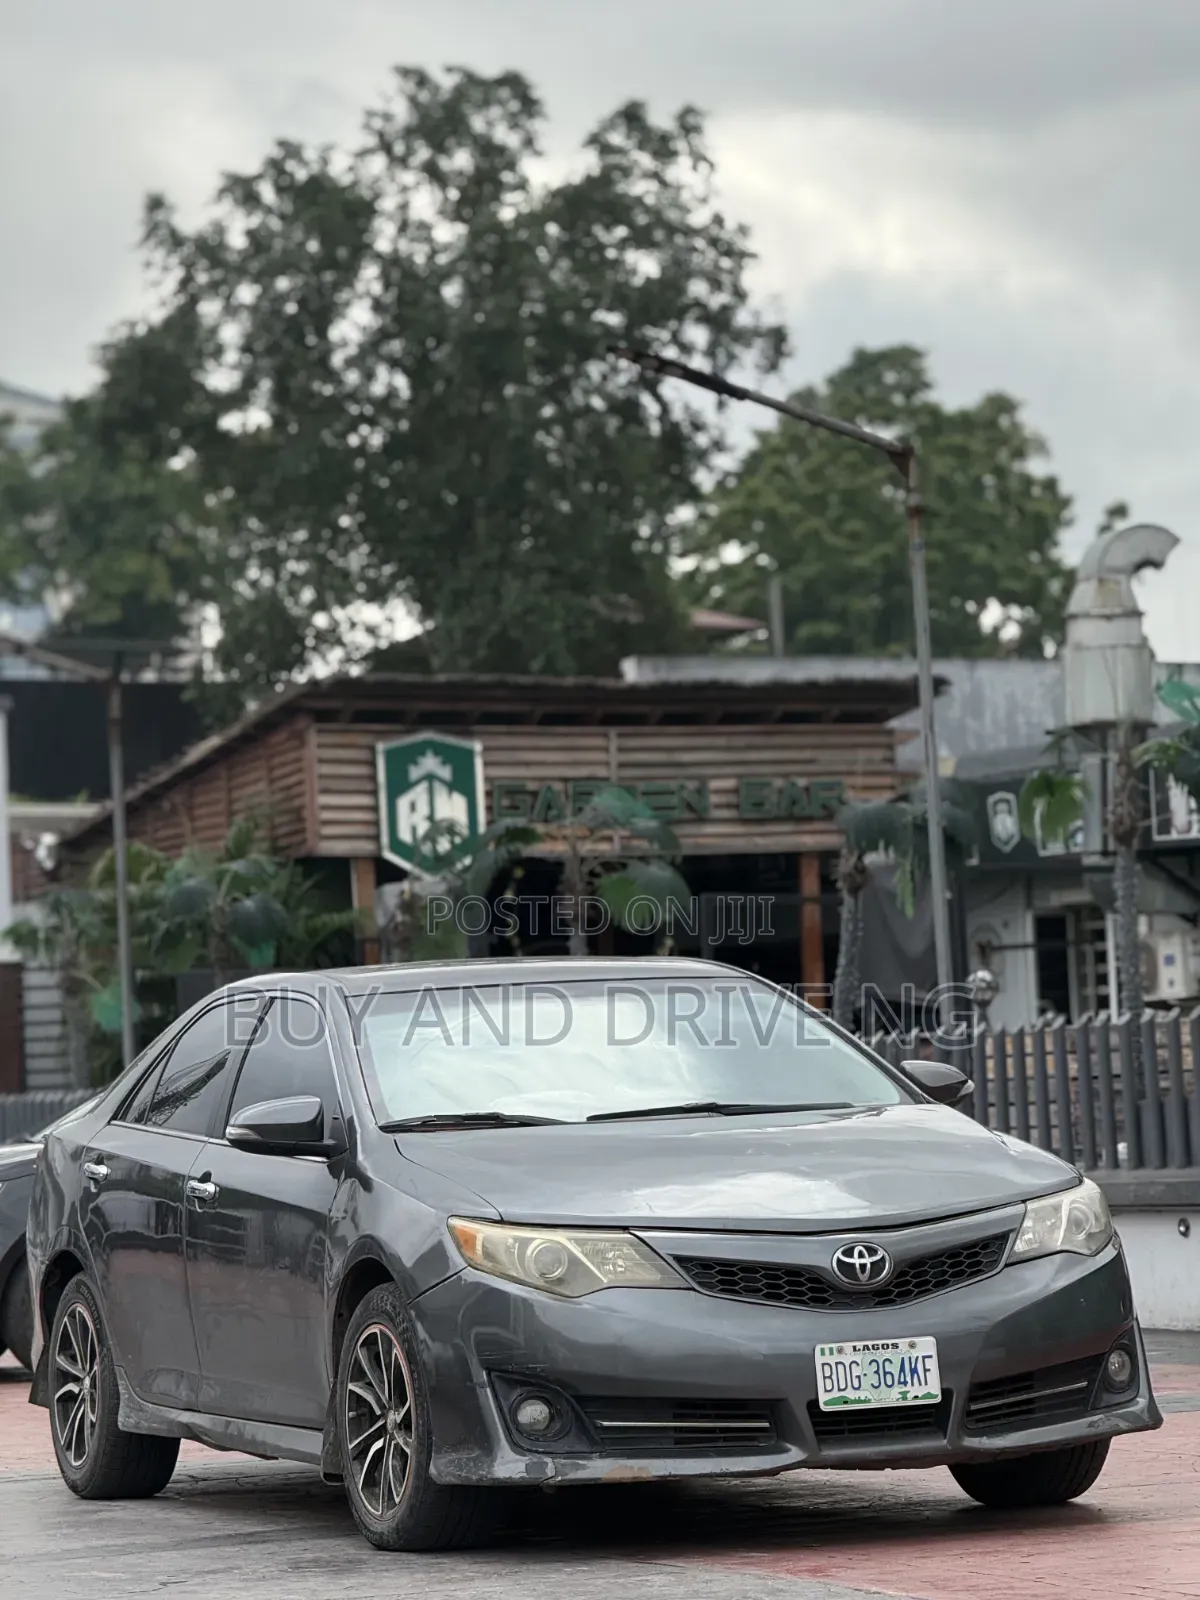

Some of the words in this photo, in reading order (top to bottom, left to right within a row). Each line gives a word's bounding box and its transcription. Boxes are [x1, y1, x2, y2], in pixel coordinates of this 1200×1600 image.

[493, 779, 709, 821] GAREN
[739, 777, 846, 819] BAR
[852, 1342, 900, 1352] LAGOS
